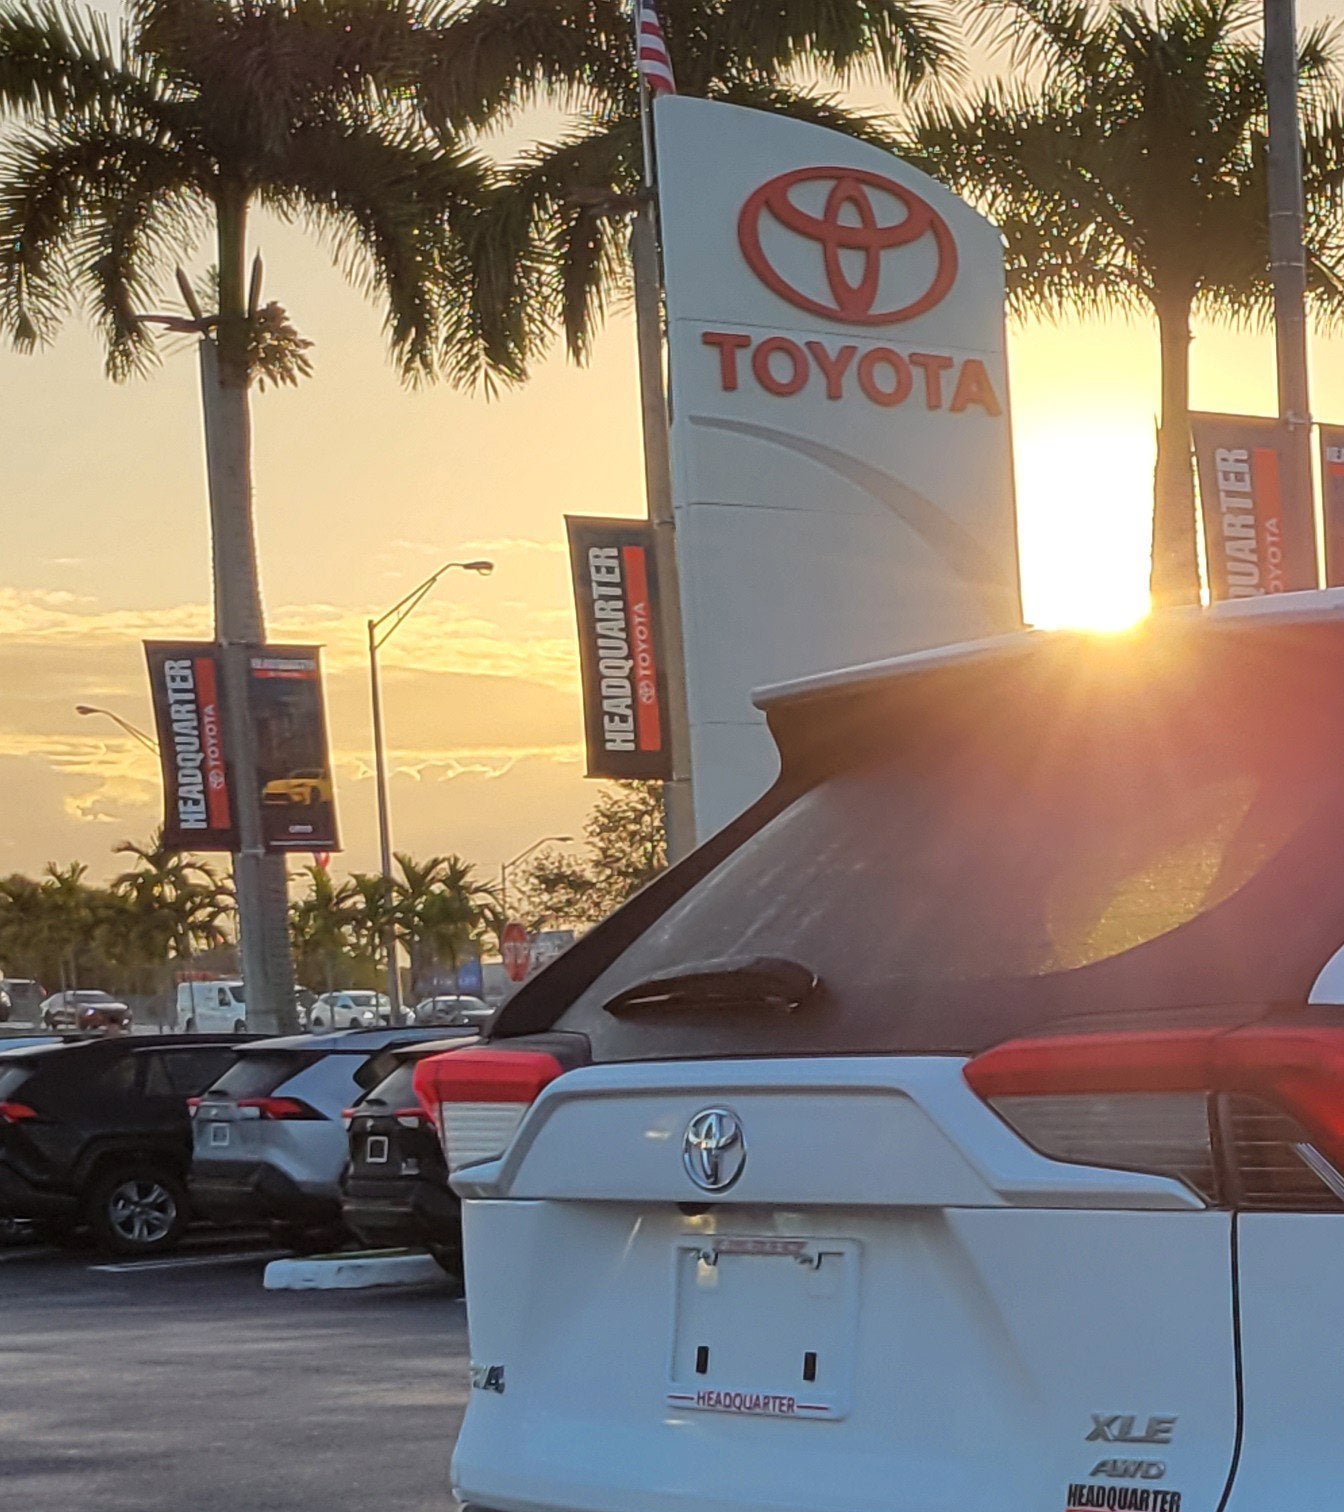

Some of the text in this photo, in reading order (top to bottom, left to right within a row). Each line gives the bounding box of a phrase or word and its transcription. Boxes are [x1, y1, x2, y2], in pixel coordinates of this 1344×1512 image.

[702, 331, 1001, 417] TOYOTA
[1265, 517, 1283, 594] OYOTA
[588, 547, 635, 751] HEADQUARTER
[633, 601, 652, 677] TOYOTA
[164, 659, 207, 829] HEADQUARTER
[203, 704, 221, 767] TOYOTA
[697, 1391, 795, 1413] HEADQUARTER
[1085, 1414, 1178, 1444] XLE
[1089, 1459, 1166, 1479] AWD
